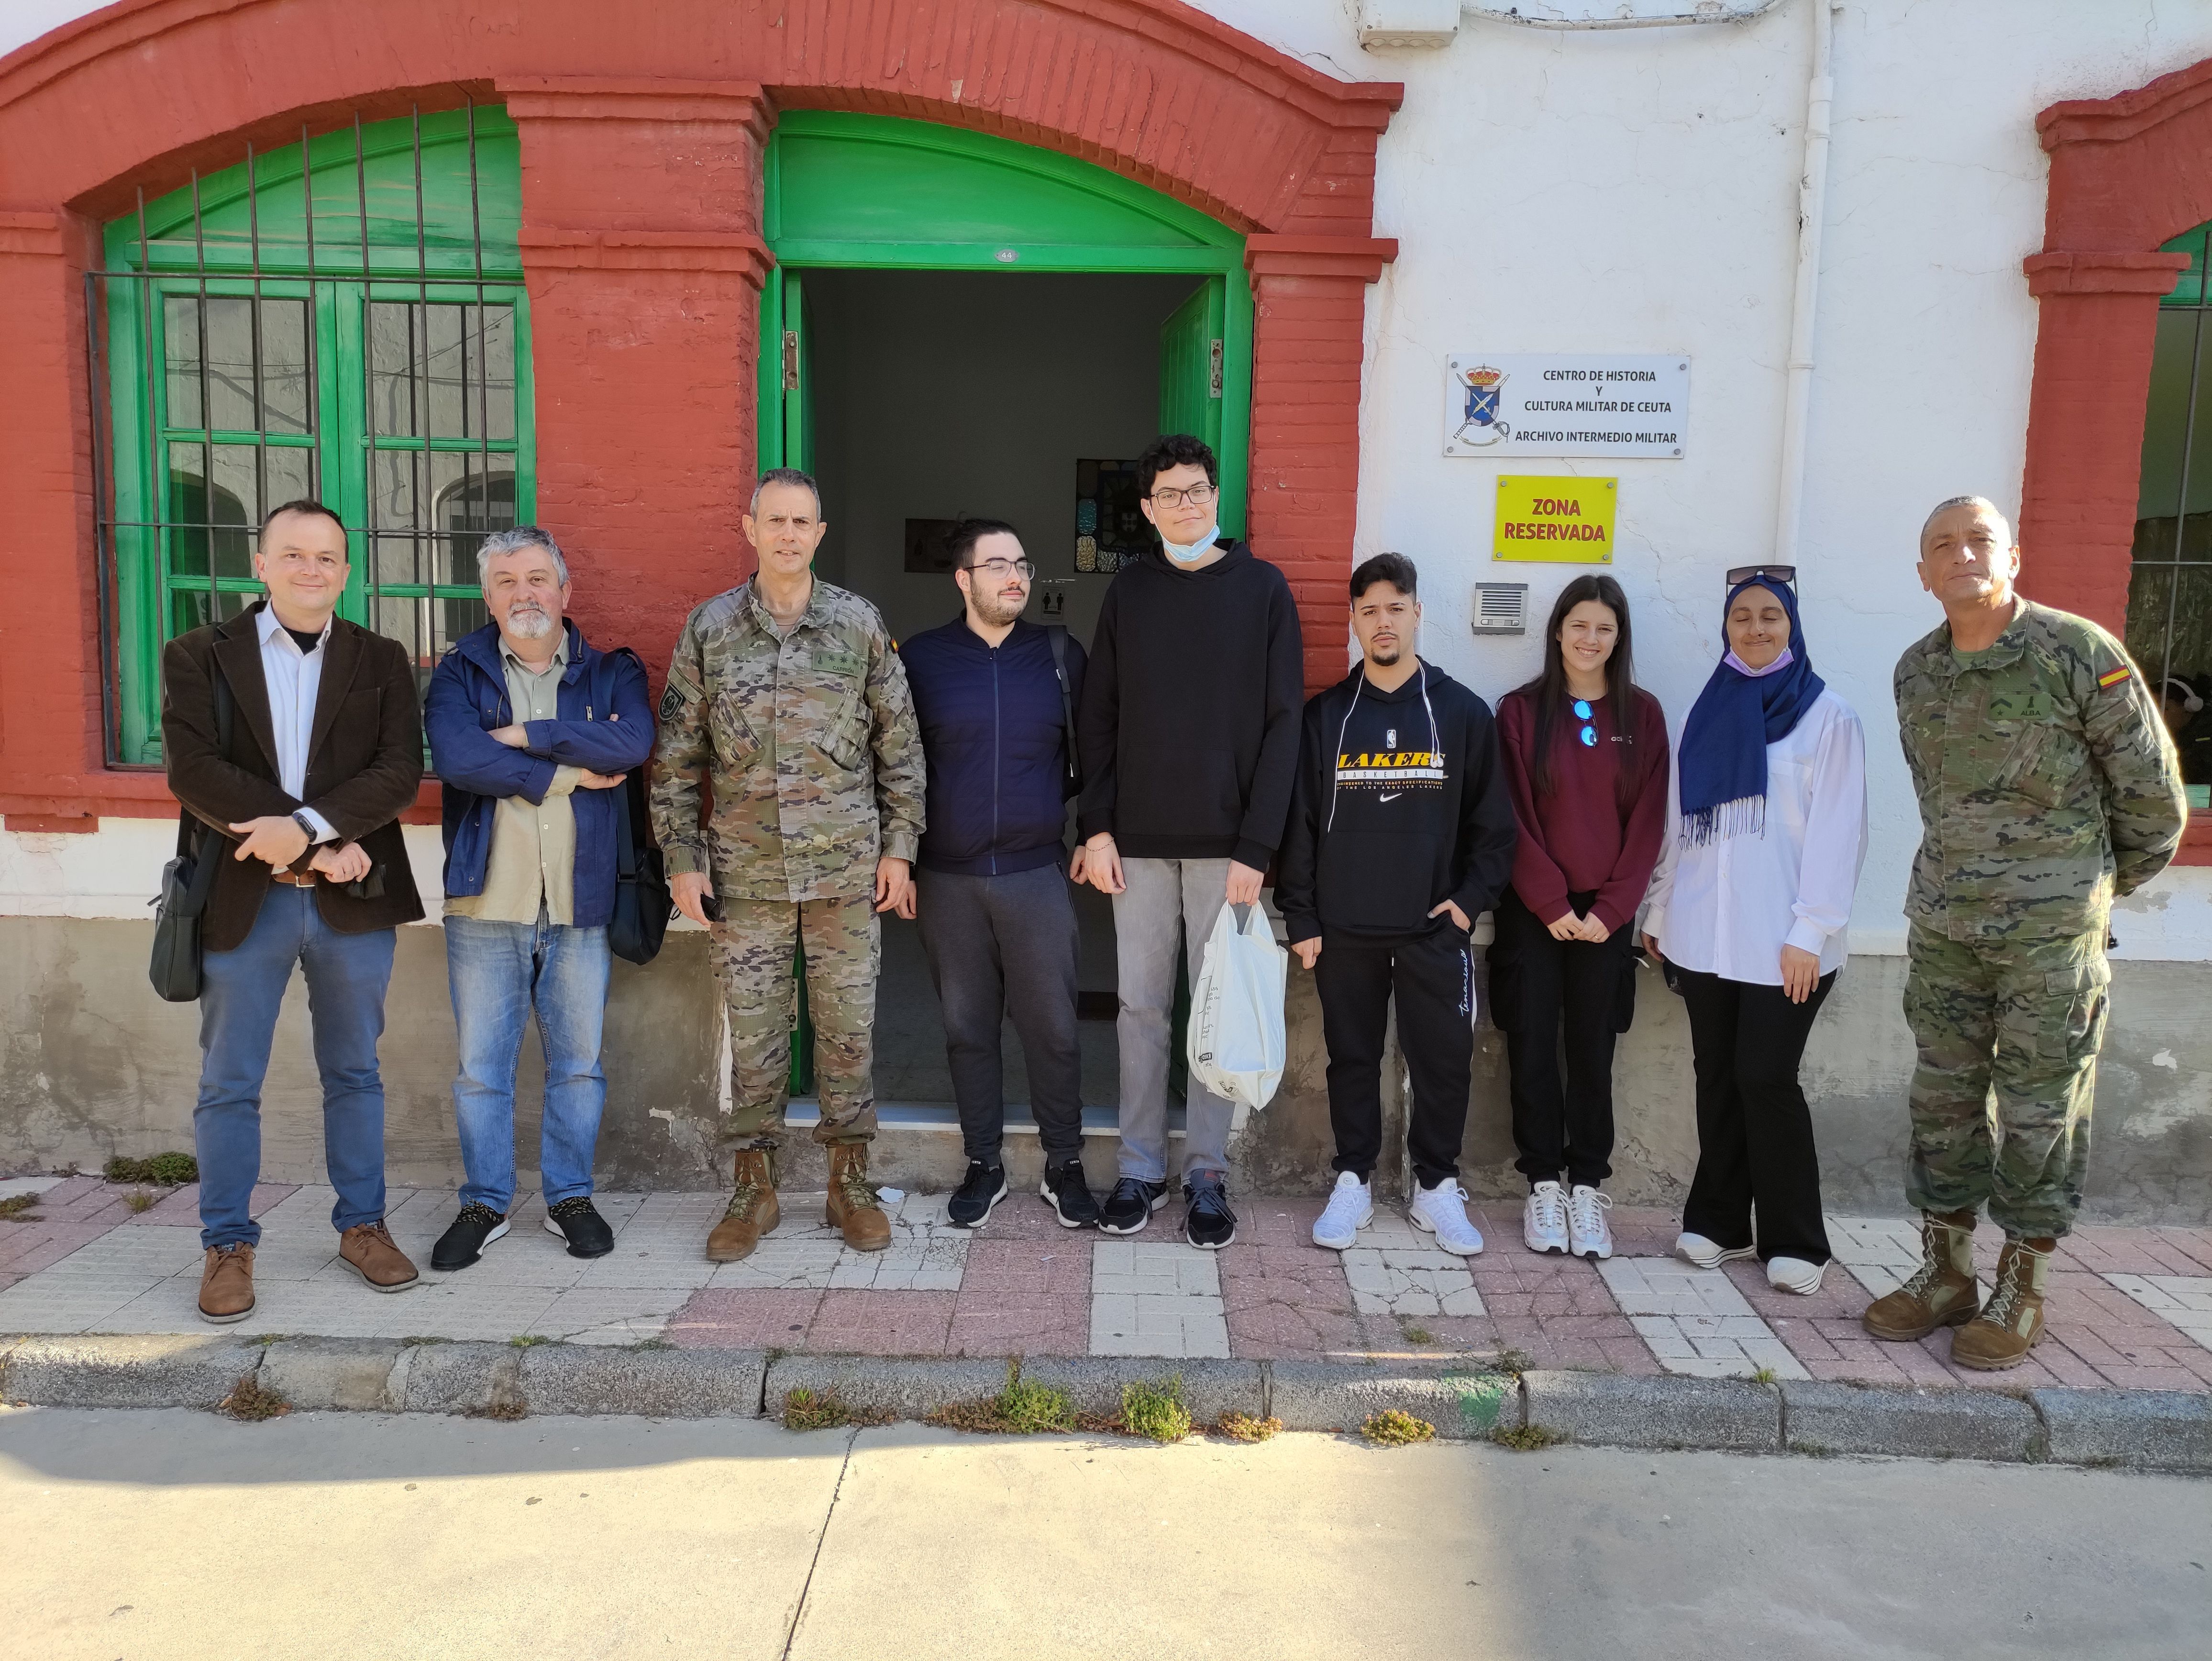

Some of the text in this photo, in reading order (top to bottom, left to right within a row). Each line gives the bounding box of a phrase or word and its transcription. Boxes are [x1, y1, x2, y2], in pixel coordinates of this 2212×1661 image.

[1543, 370, 1656, 382] CENTRO DE HISTORIA
[1595, 386, 1603, 397] Y
[1525, 400, 1671, 412] CULTURA MILITAR DE CEUTA
[1515, 431, 1677, 443] ARCHIVO INTERMEDIO MILITAR
[1532, 498, 1581, 516] ZONA
[1504, 522, 1606, 542] RESERVADA
[832, 665, 854, 674] CARRIÓN
[1343, 770, 1437, 779] BASKETBALL
